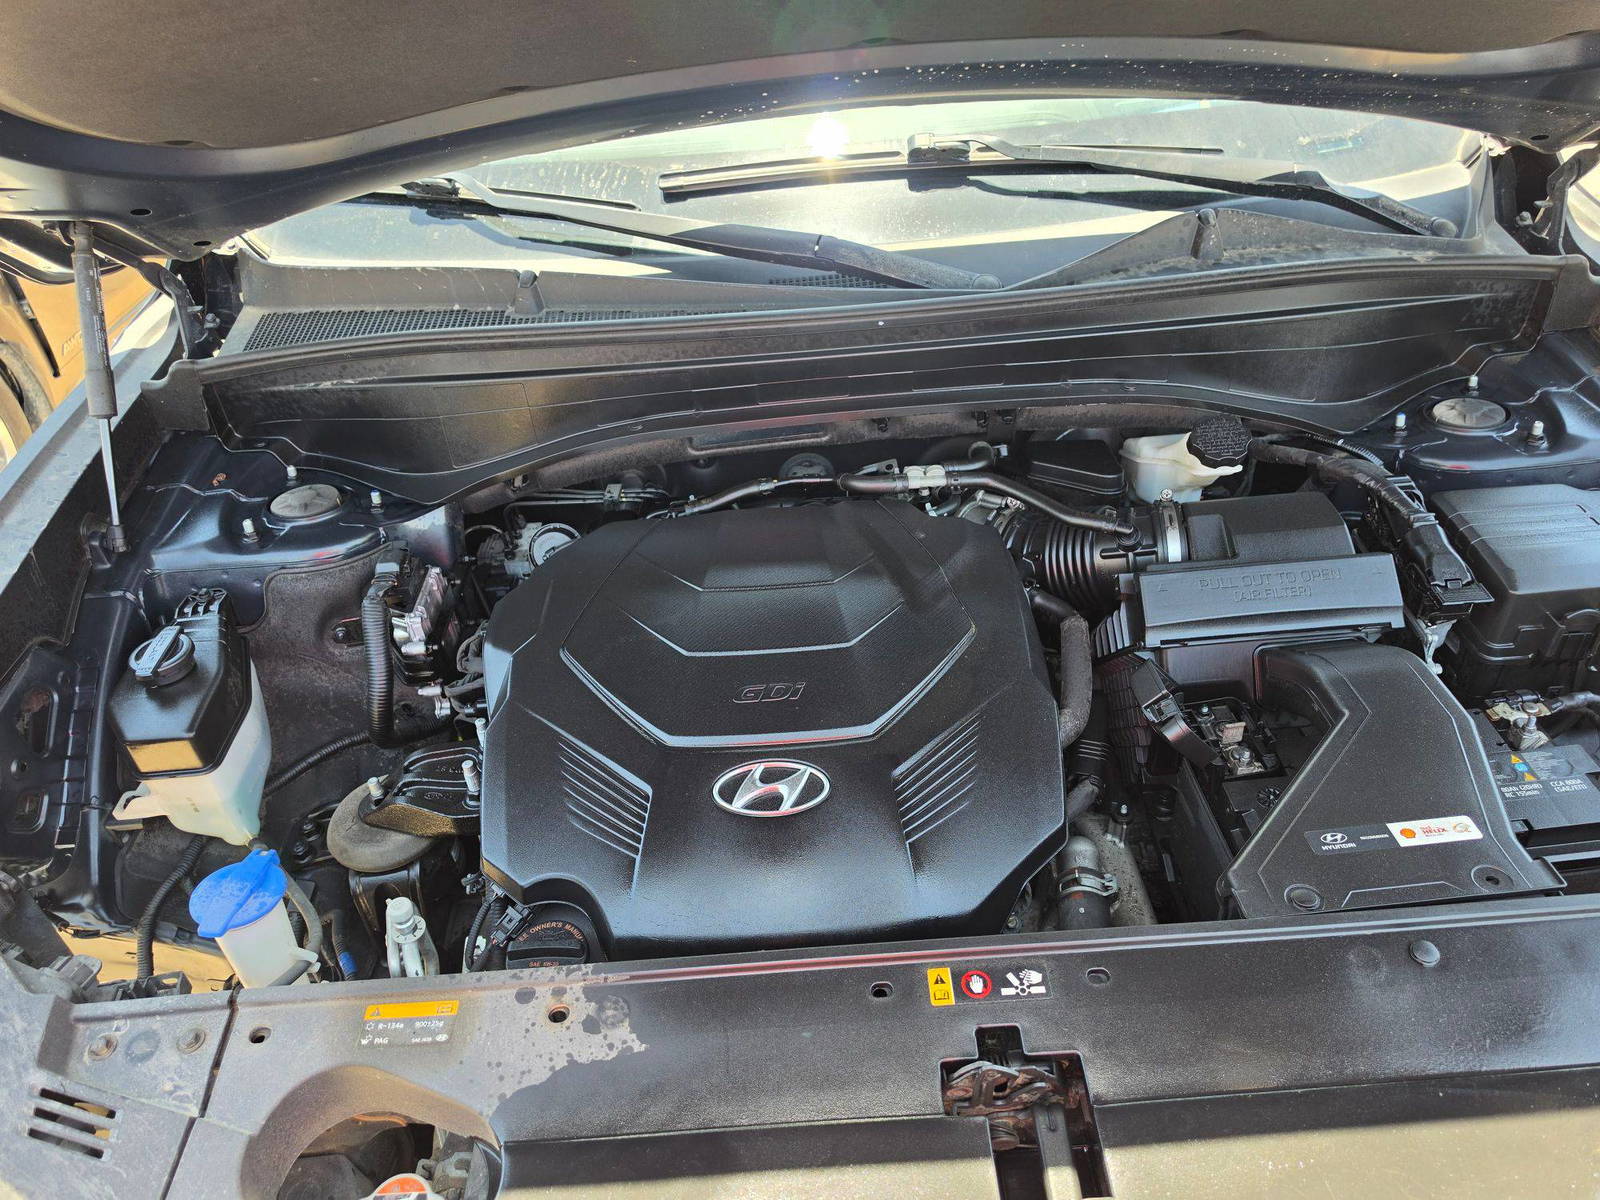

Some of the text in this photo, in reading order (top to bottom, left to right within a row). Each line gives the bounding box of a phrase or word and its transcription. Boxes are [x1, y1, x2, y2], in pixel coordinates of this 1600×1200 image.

[1200, 567, 1342, 591] PULL OUT TO OPEN
[1233, 585, 1313, 602] (AIR FILTER)
[1321, 842, 1357, 851] HYUNDAI
[529, 921, 563, 934] OWNER'S
[374, 1036, 389, 1045] PAG
